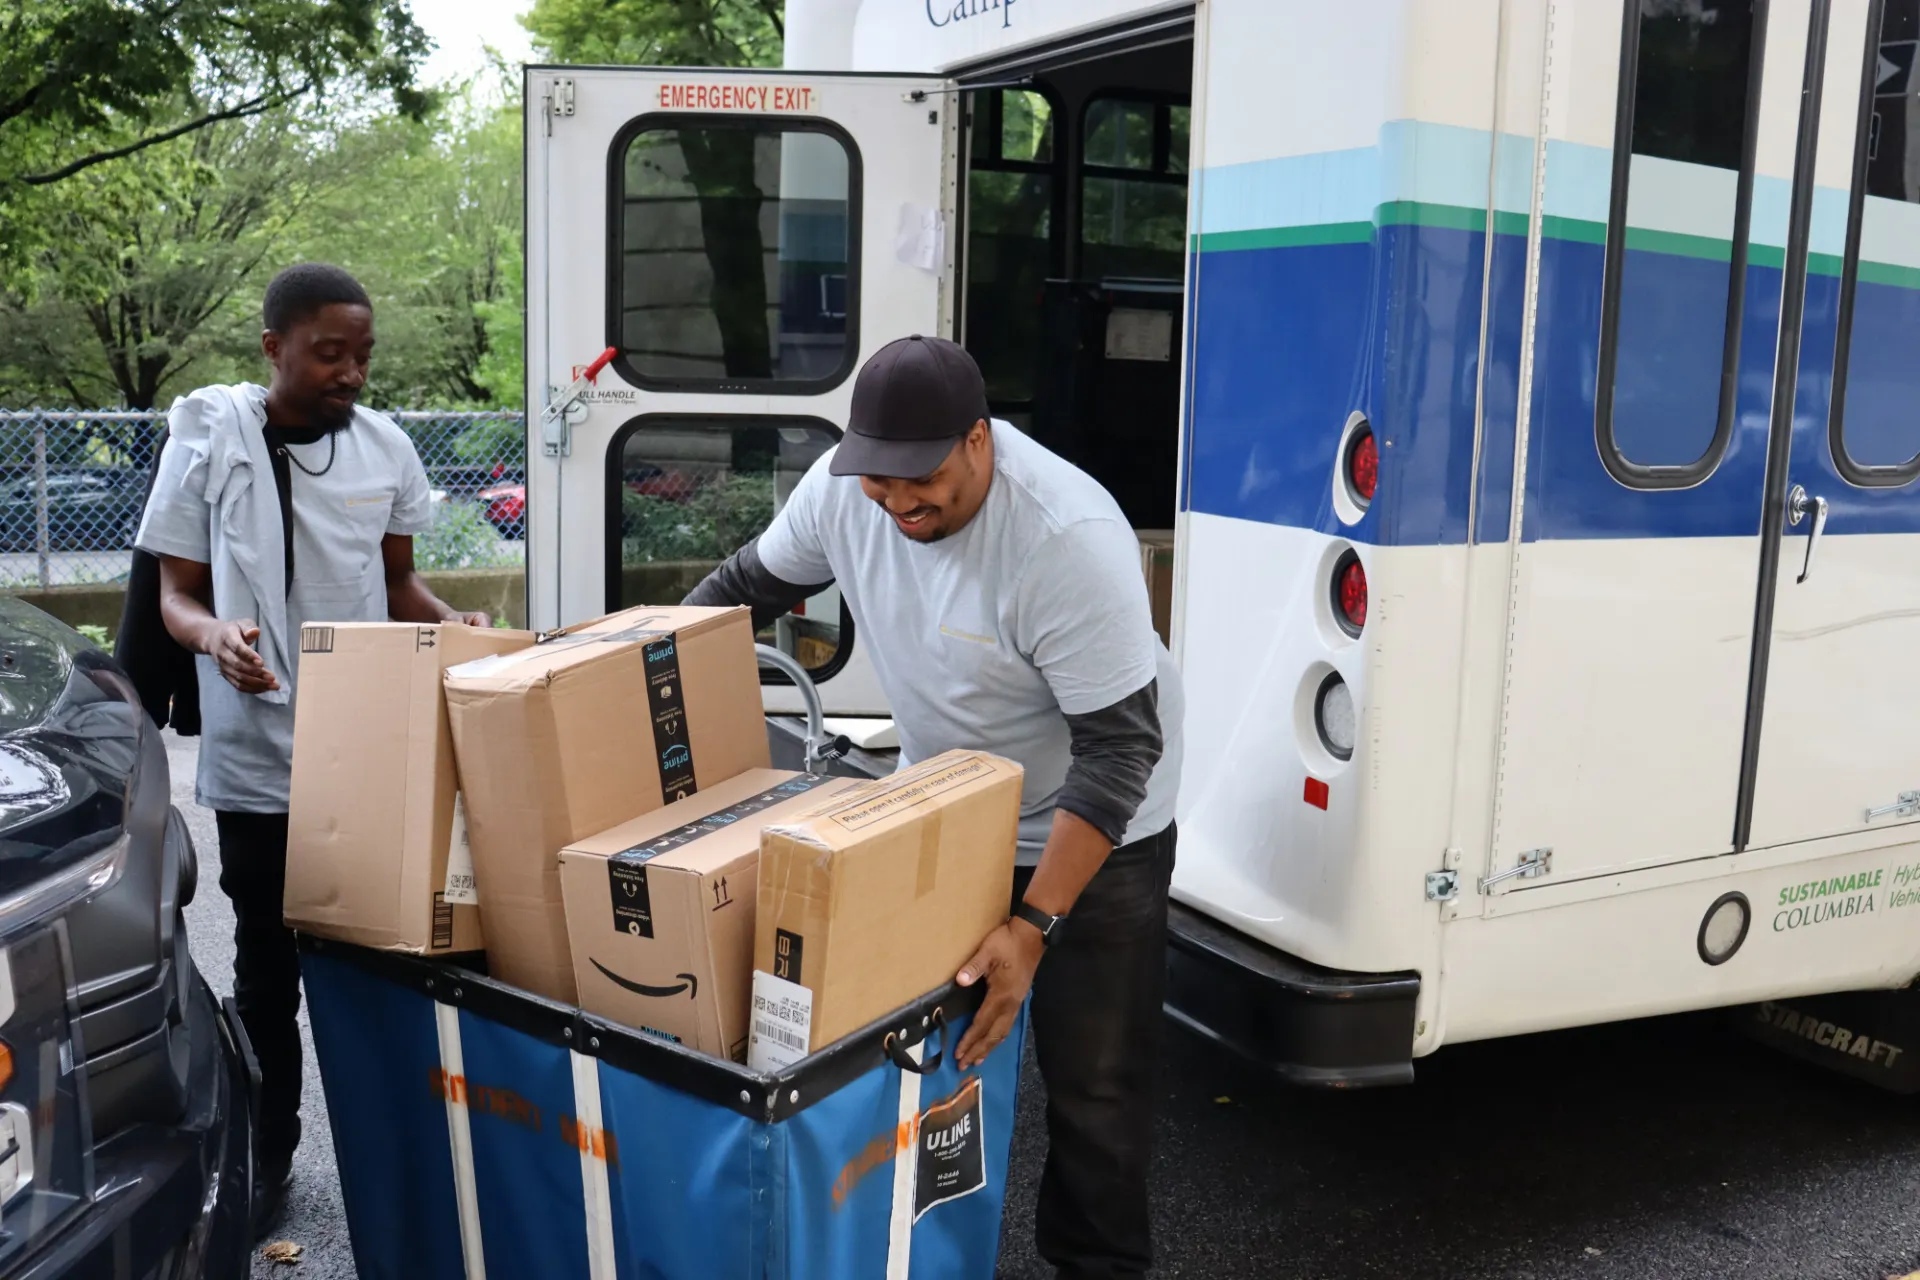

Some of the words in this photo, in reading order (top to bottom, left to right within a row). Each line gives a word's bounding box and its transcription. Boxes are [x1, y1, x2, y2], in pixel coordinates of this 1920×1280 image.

[660, 84, 768, 111] EMERGENCY
[774, 87, 811, 110] EXIT
[598, 391, 636, 399] HANDLE
[648, 644, 674, 662] prime
[663, 749, 689, 770] prime
[842, 808, 869, 823] Please
[869, 802, 887, 814] open
[893, 785, 925, 803] carefully
[930, 777, 948, 789] case
[946, 773, 956, 782] of
[1778, 868, 1883, 905] SUSTAINABLE
[1773, 893, 1874, 932] COLUMBIA
[1757, 1000, 1903, 1069] STARCRAFT
[926, 1113, 971, 1150] ULINE
